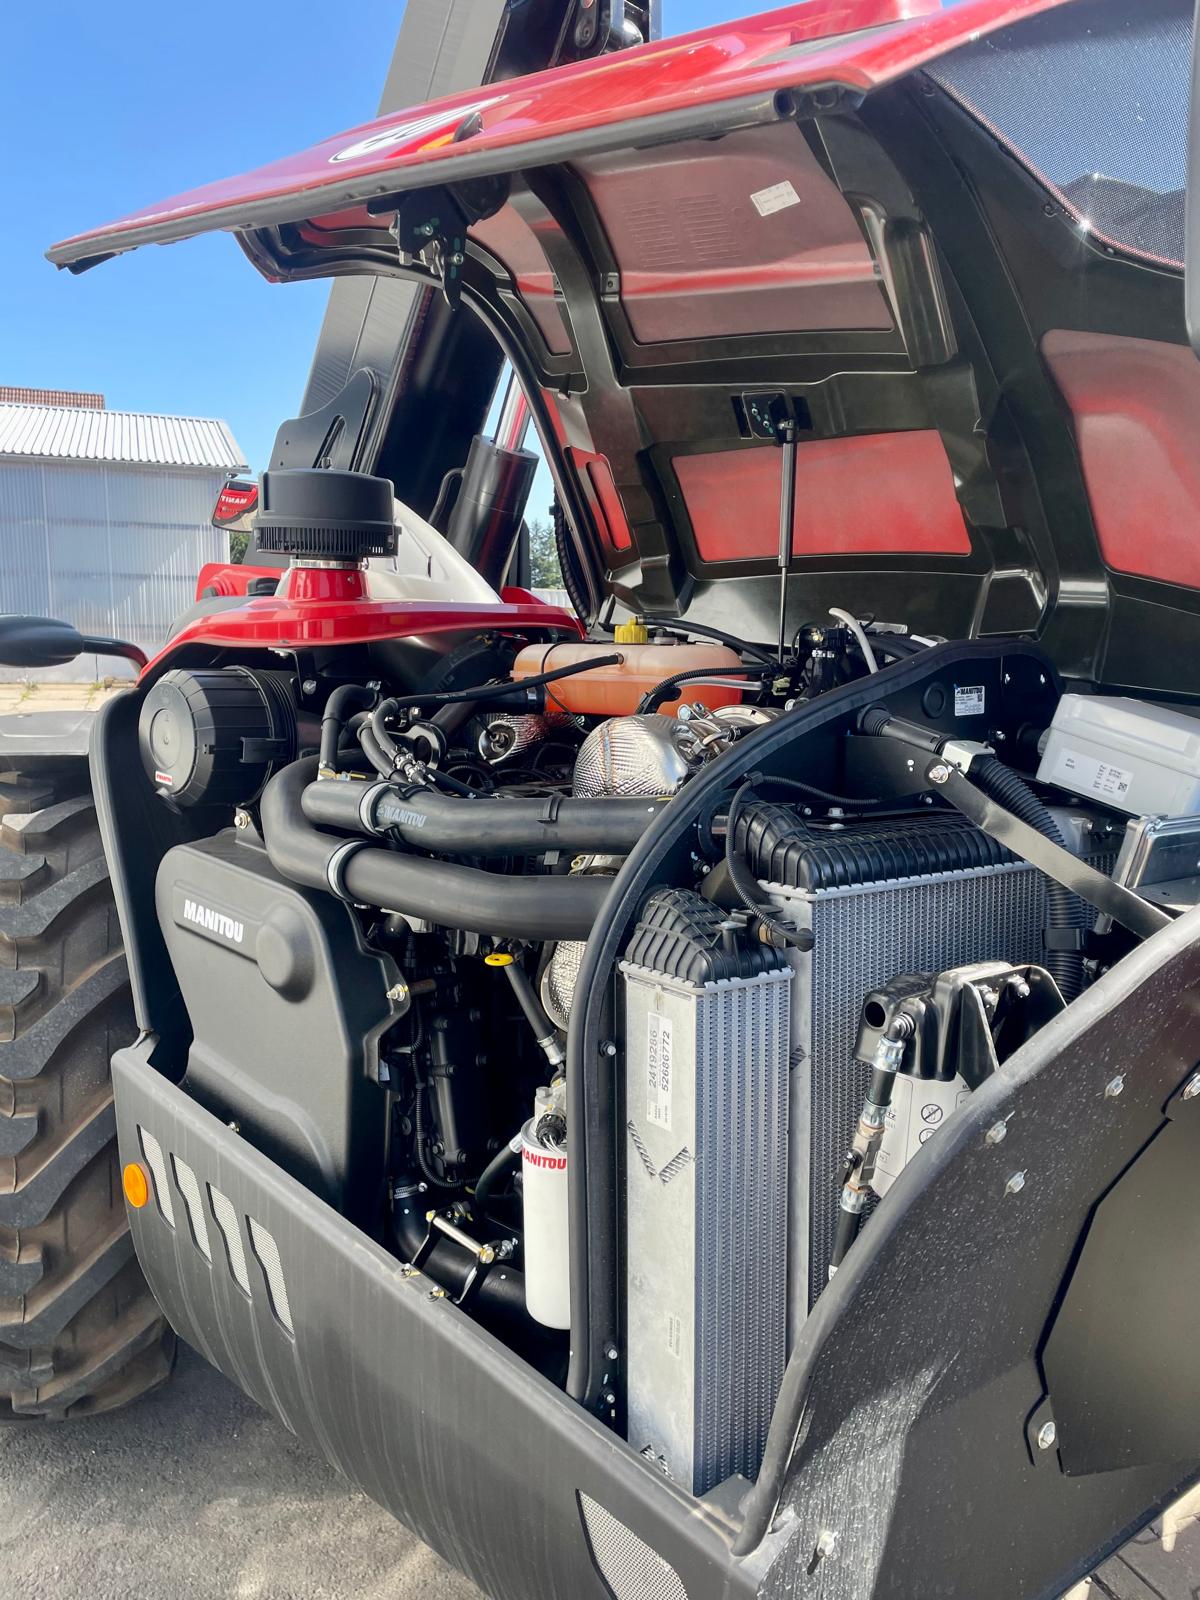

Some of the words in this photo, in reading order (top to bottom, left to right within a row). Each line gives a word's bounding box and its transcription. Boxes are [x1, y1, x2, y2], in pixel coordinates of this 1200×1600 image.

[384, 805, 427, 828] MANITOU
[183, 899, 244, 943] MANITOU
[649, 1030, 658, 1089] 2419286
[661, 1031, 670, 1092] 52686772
